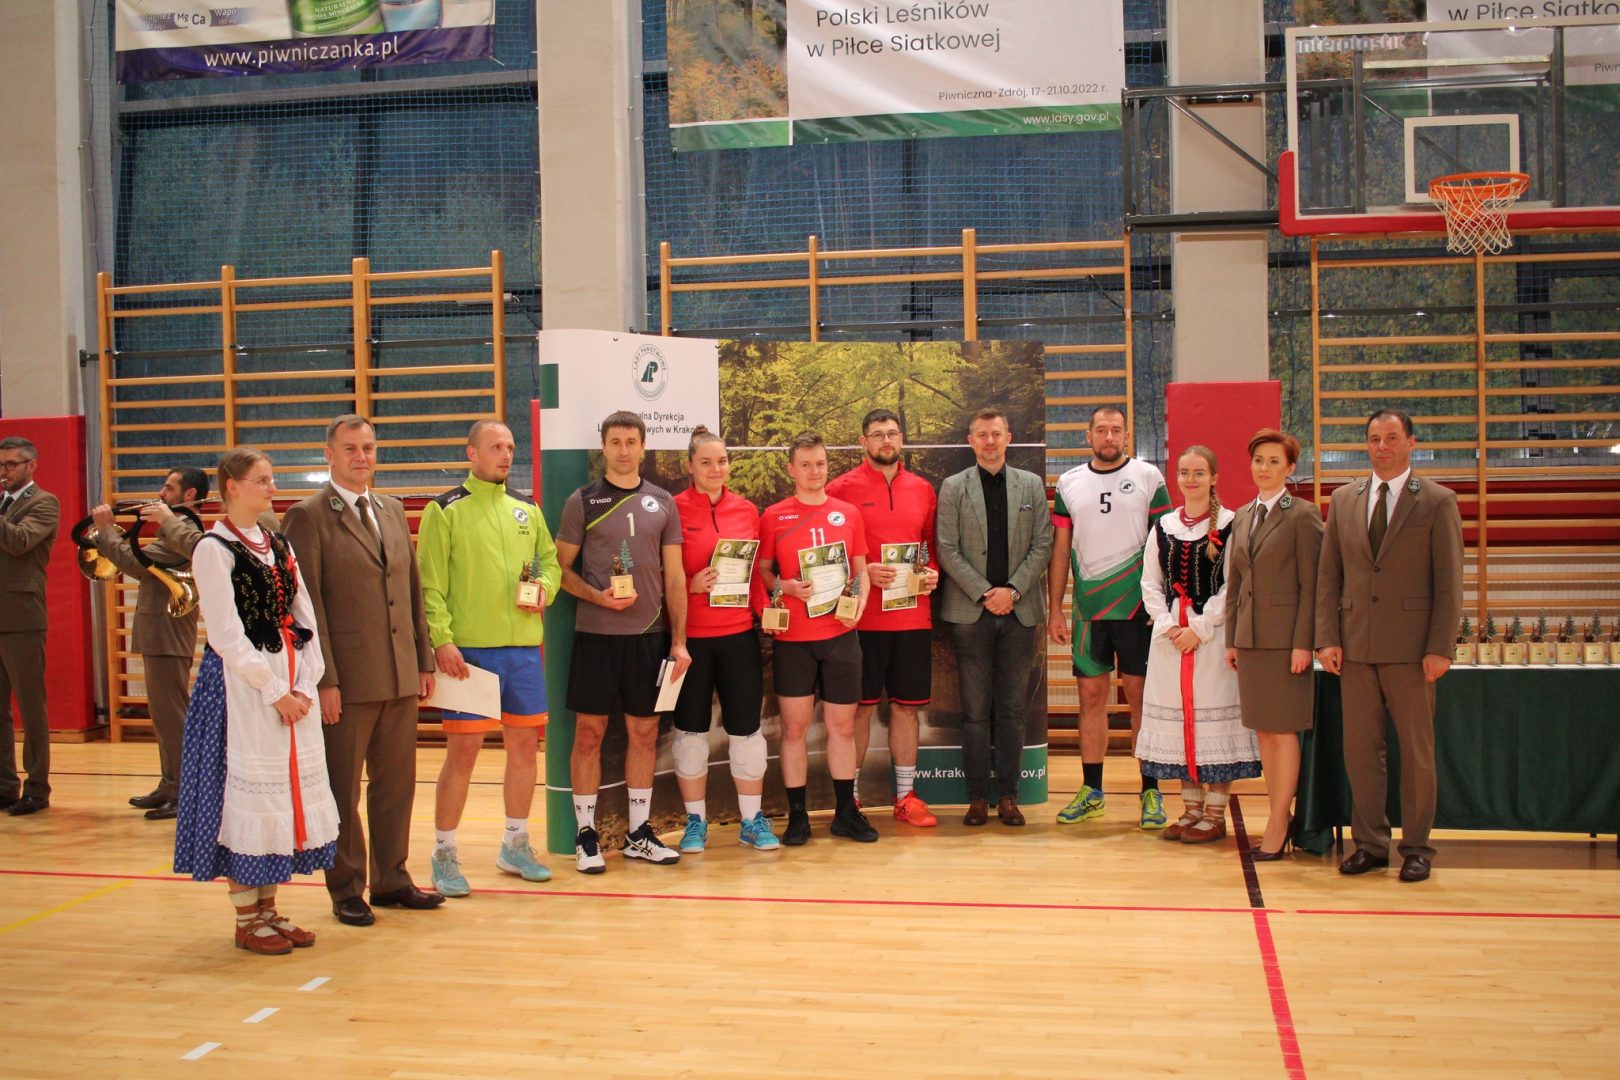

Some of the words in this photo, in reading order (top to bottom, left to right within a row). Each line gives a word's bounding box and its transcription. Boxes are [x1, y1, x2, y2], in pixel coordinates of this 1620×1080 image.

[191, 13, 206, 25] Ca
[816, 7, 879, 28] Polski
[887, 0, 990, 24] Leśników
[1448, 8, 1469, 21] w
[1476, 3, 1535, 20] Piłce
[204, 35, 399, 69] www.piwniczanka.pl
[806, 43, 825, 58] w
[832, 36, 883, 57] Piłce
[891, 28, 1001, 53] Siatkowej
[1023, 111, 1109, 125] www.lasy.gov.pl
[653, 412, 685, 423] Dyrekcja
[673, 424, 695, 434] Krako
[1100, 491, 1112, 514] 5
[626, 512, 635, 537] 1
[809, 528, 825, 548] 11
